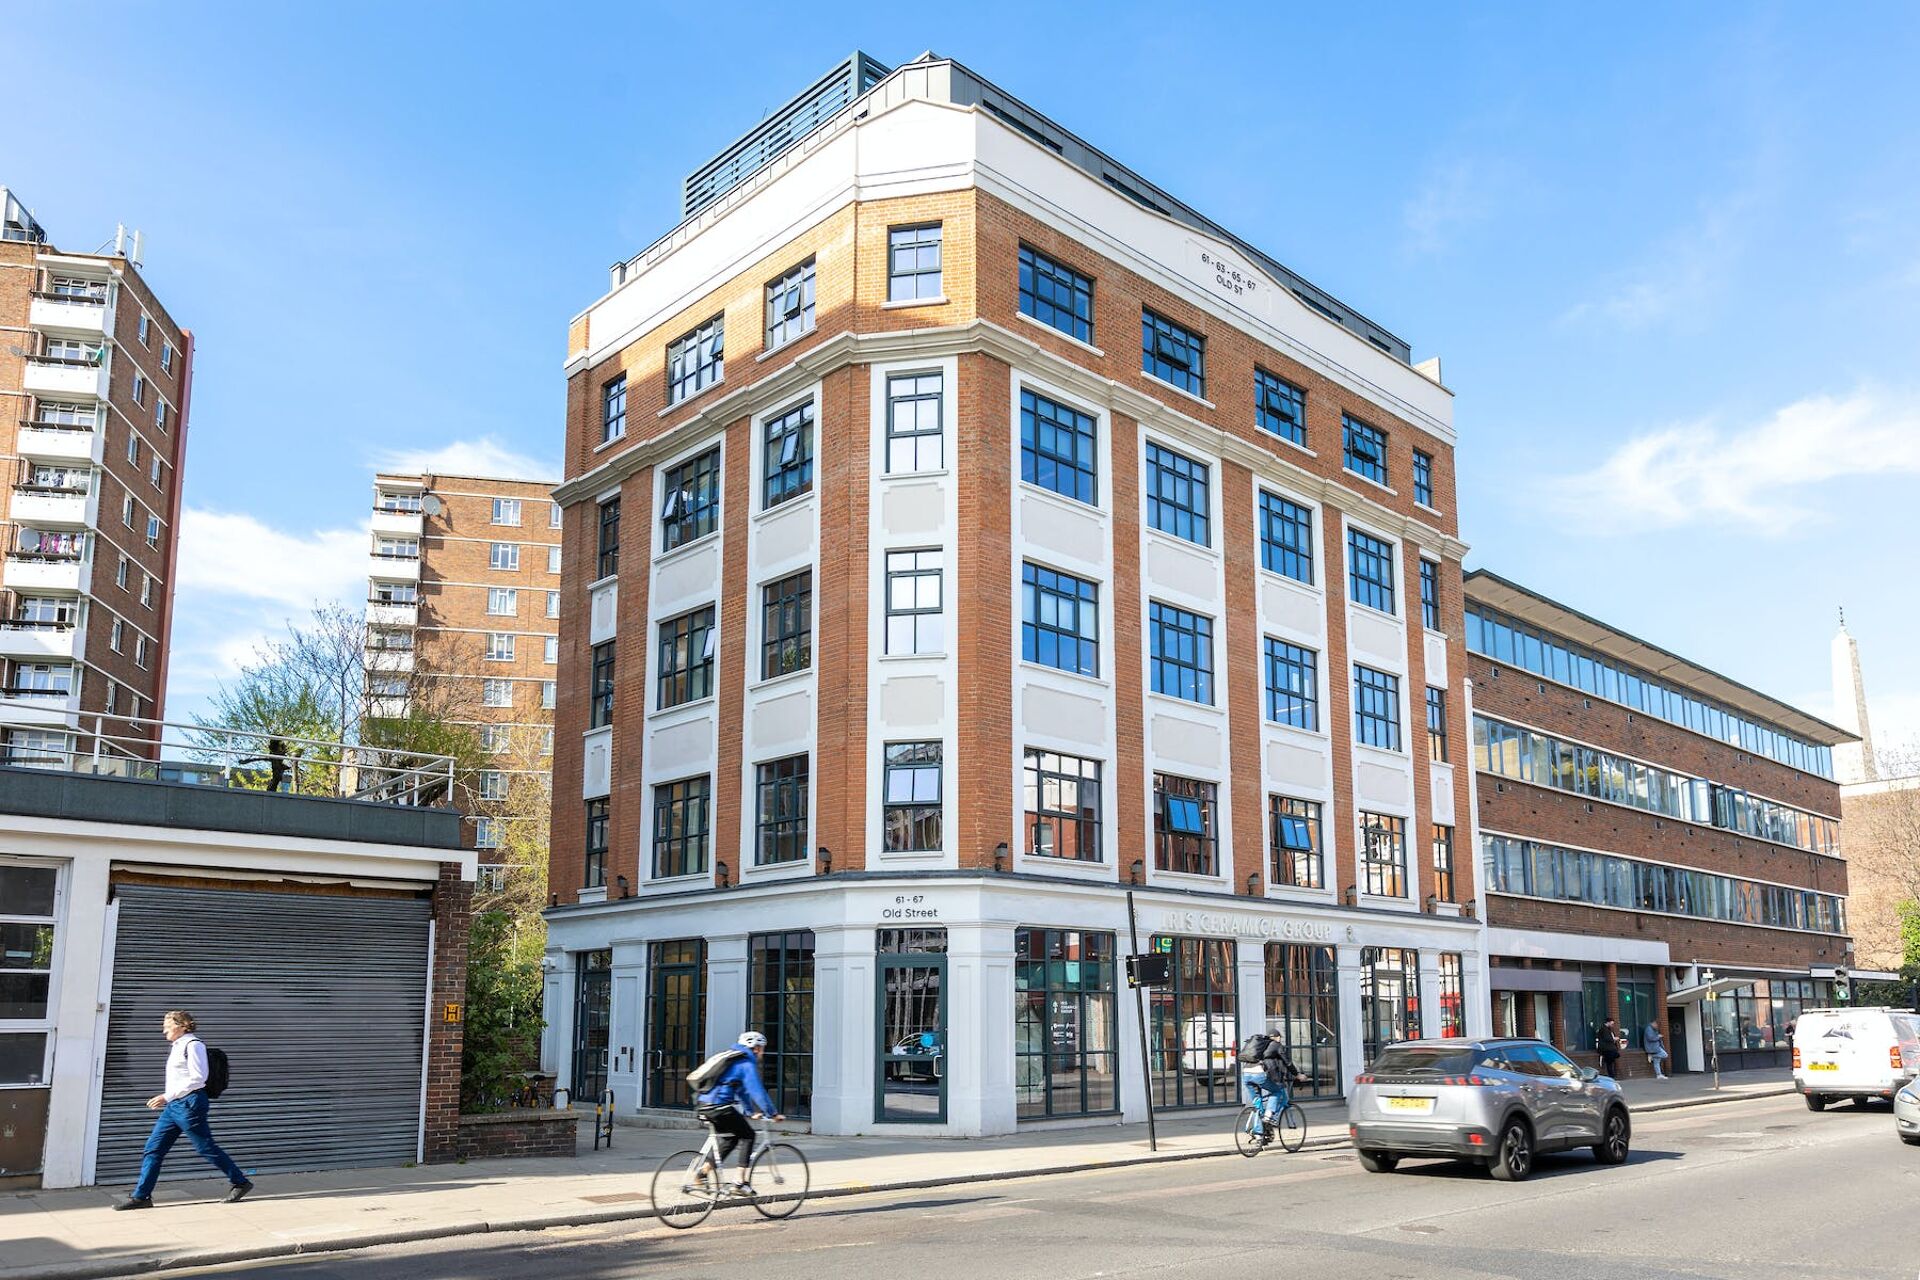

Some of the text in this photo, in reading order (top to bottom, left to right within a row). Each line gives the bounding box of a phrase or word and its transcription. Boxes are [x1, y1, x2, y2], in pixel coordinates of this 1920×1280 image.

[1201, 253, 1209, 264] 61
[1216, 261, 1225, 273] 63
[1232, 271, 1241, 282] 65
[1247, 280, 1256, 290] 67
[1216, 274, 1243, 295] OLD ST
[895, 896, 904, 904] 61
[912, 895, 924, 903] 67
[882, 908, 938, 918] Old Street
[1161, 910, 1194, 931] IRIS
[1283, 918, 1332, 940] GROUP
